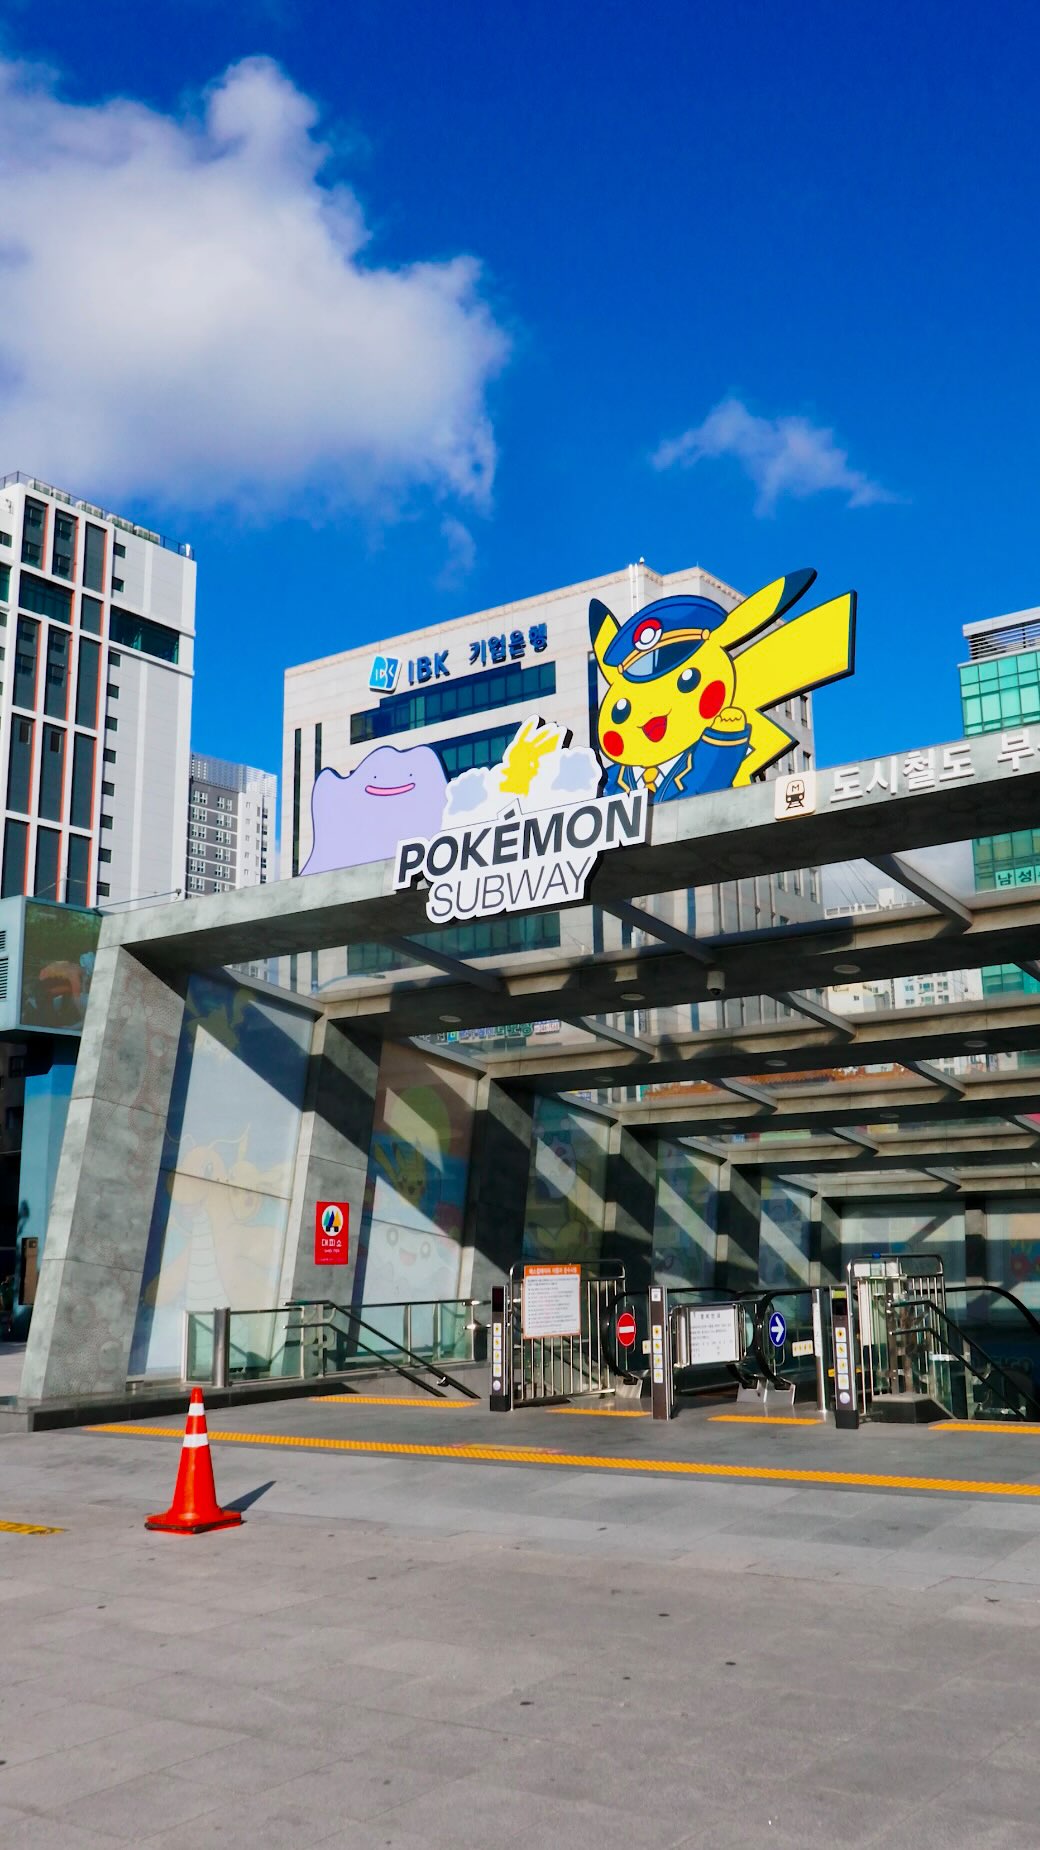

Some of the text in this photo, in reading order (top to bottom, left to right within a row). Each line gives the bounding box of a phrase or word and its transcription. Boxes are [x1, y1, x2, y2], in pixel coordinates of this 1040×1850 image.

[408, 622, 548, 685] IBK 기업은행
[830, 728, 1040, 804] 도시철도 부
[398, 795, 643, 884] POKÉMON
[431, 856, 592, 918] SUBWAY
[998, 869, 1040, 886] 남성
[321, 1239, 342, 1247] 대피소
